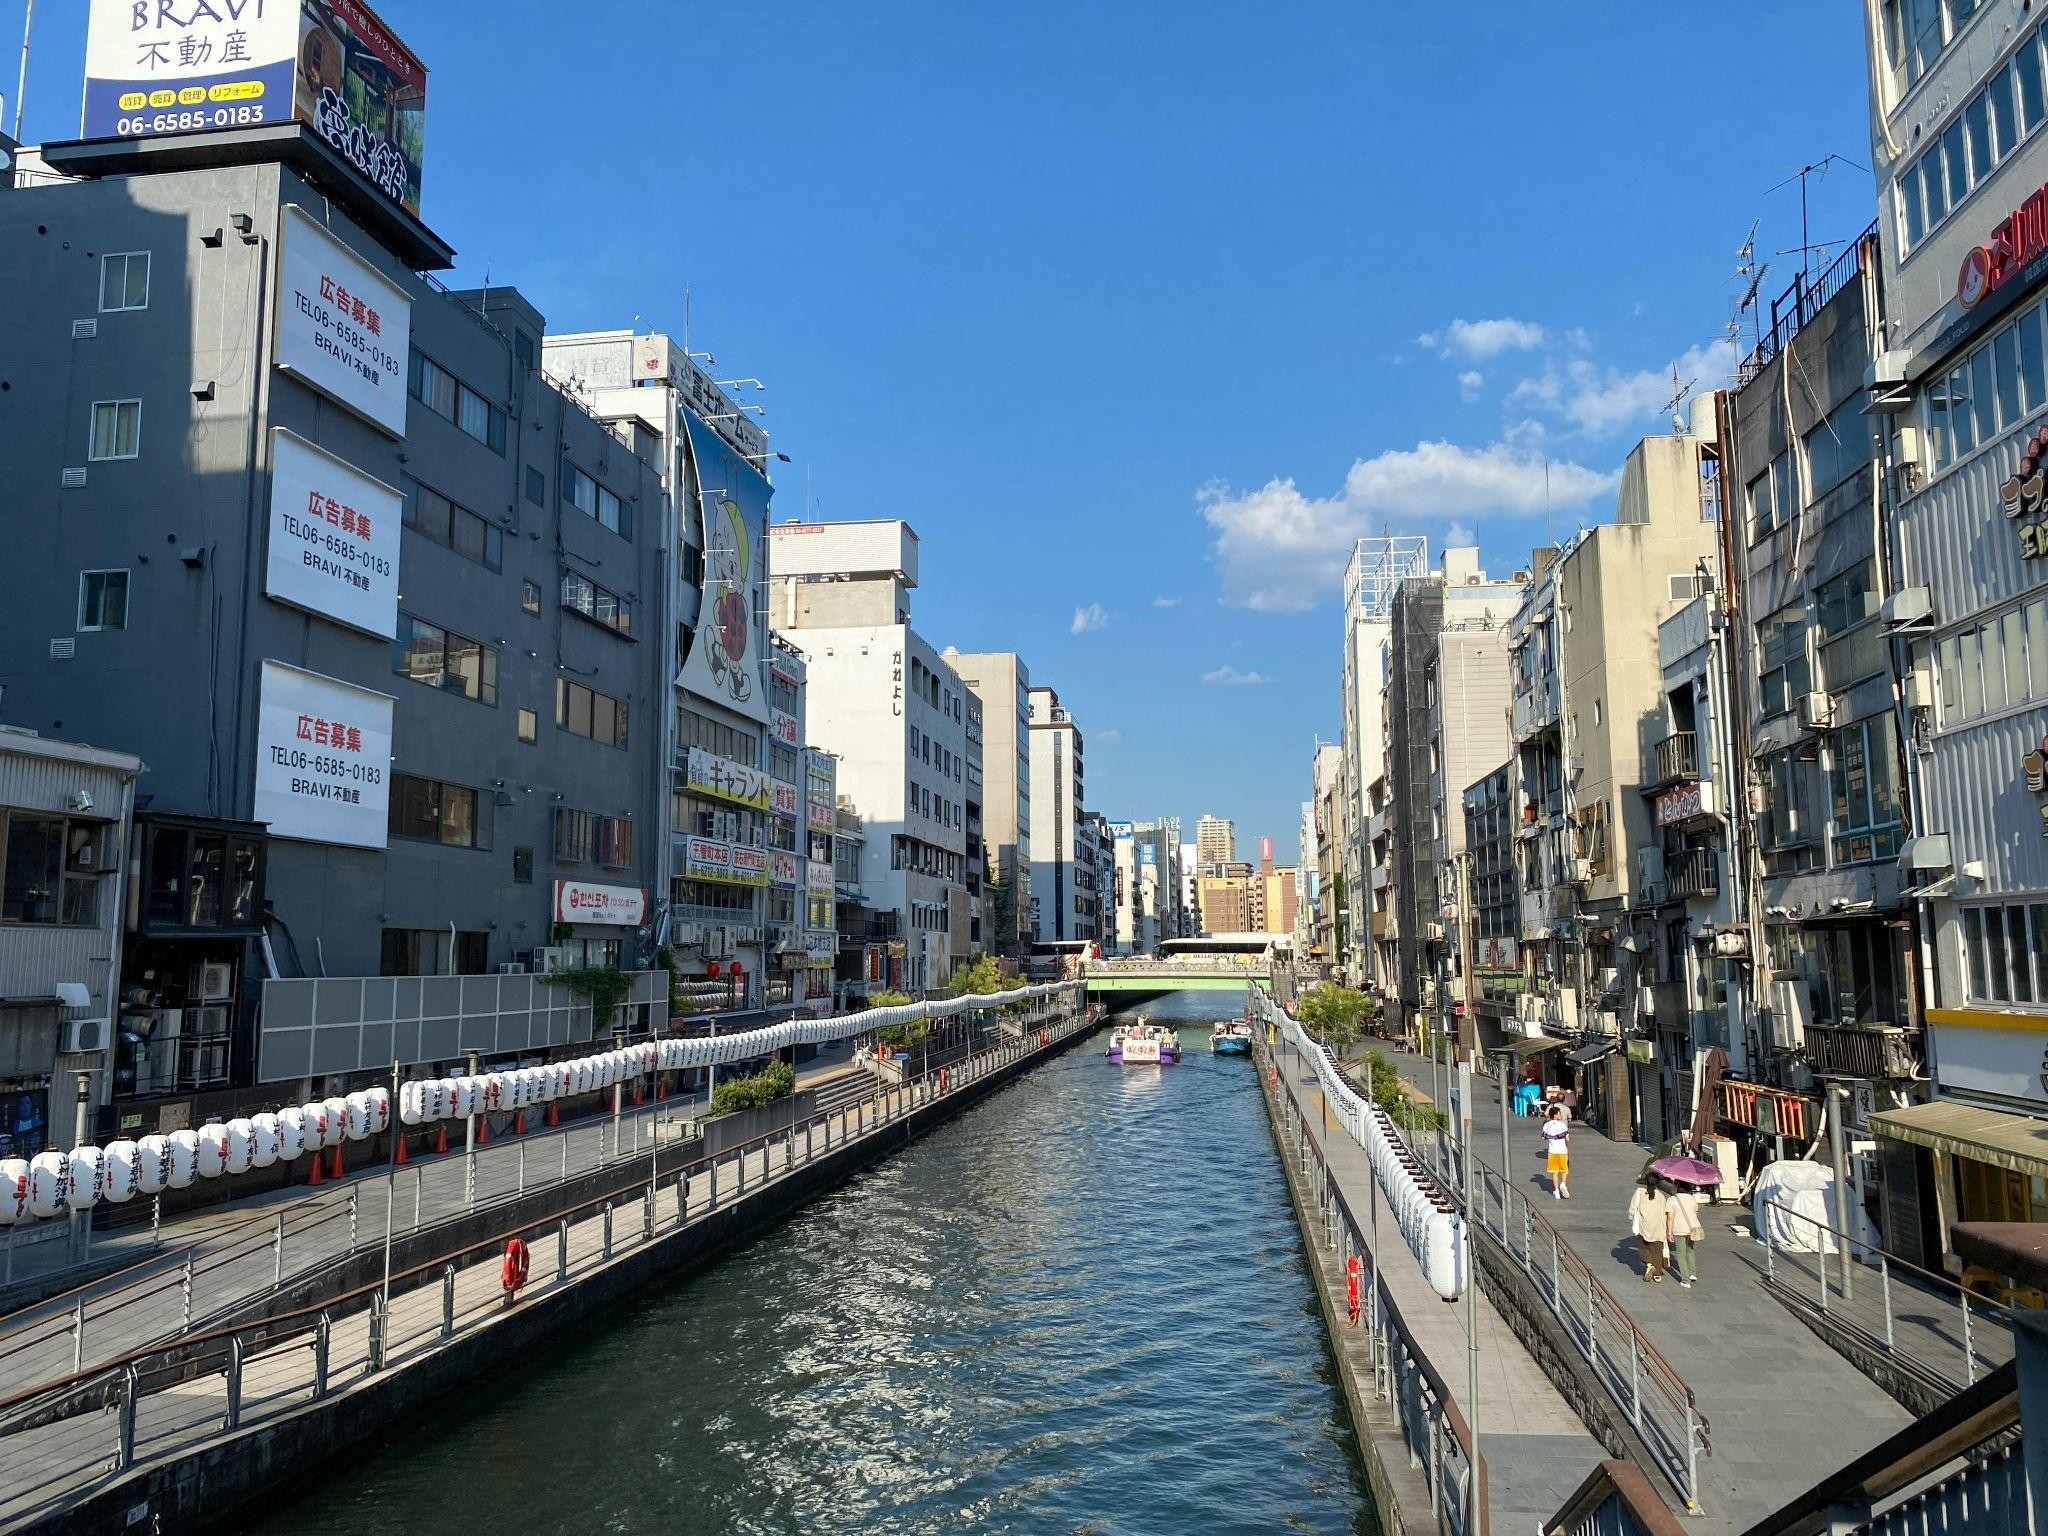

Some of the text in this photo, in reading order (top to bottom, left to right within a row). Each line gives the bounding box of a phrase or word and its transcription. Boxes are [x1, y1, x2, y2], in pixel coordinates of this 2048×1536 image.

[137, 29, 252, 71] 不動産
[183, 90, 202, 102] 管理
[213, 82, 260, 97] リフォーム
[117, 105, 264, 135] 06-6585-0183
[319, 274, 381, 338] 広告募集
[295, 290, 400, 377] TEL06-6585-0183
[308, 490, 371, 542] 広告募集
[282, 513, 391, 577] TEL06-6585-0183
[892, 650, 902, 717] かねよし
[296, 714, 361, 753] 広告募集
[271, 745, 381, 785] TEL06-6585-0183
[710, 760, 769, 807] ギャラント
